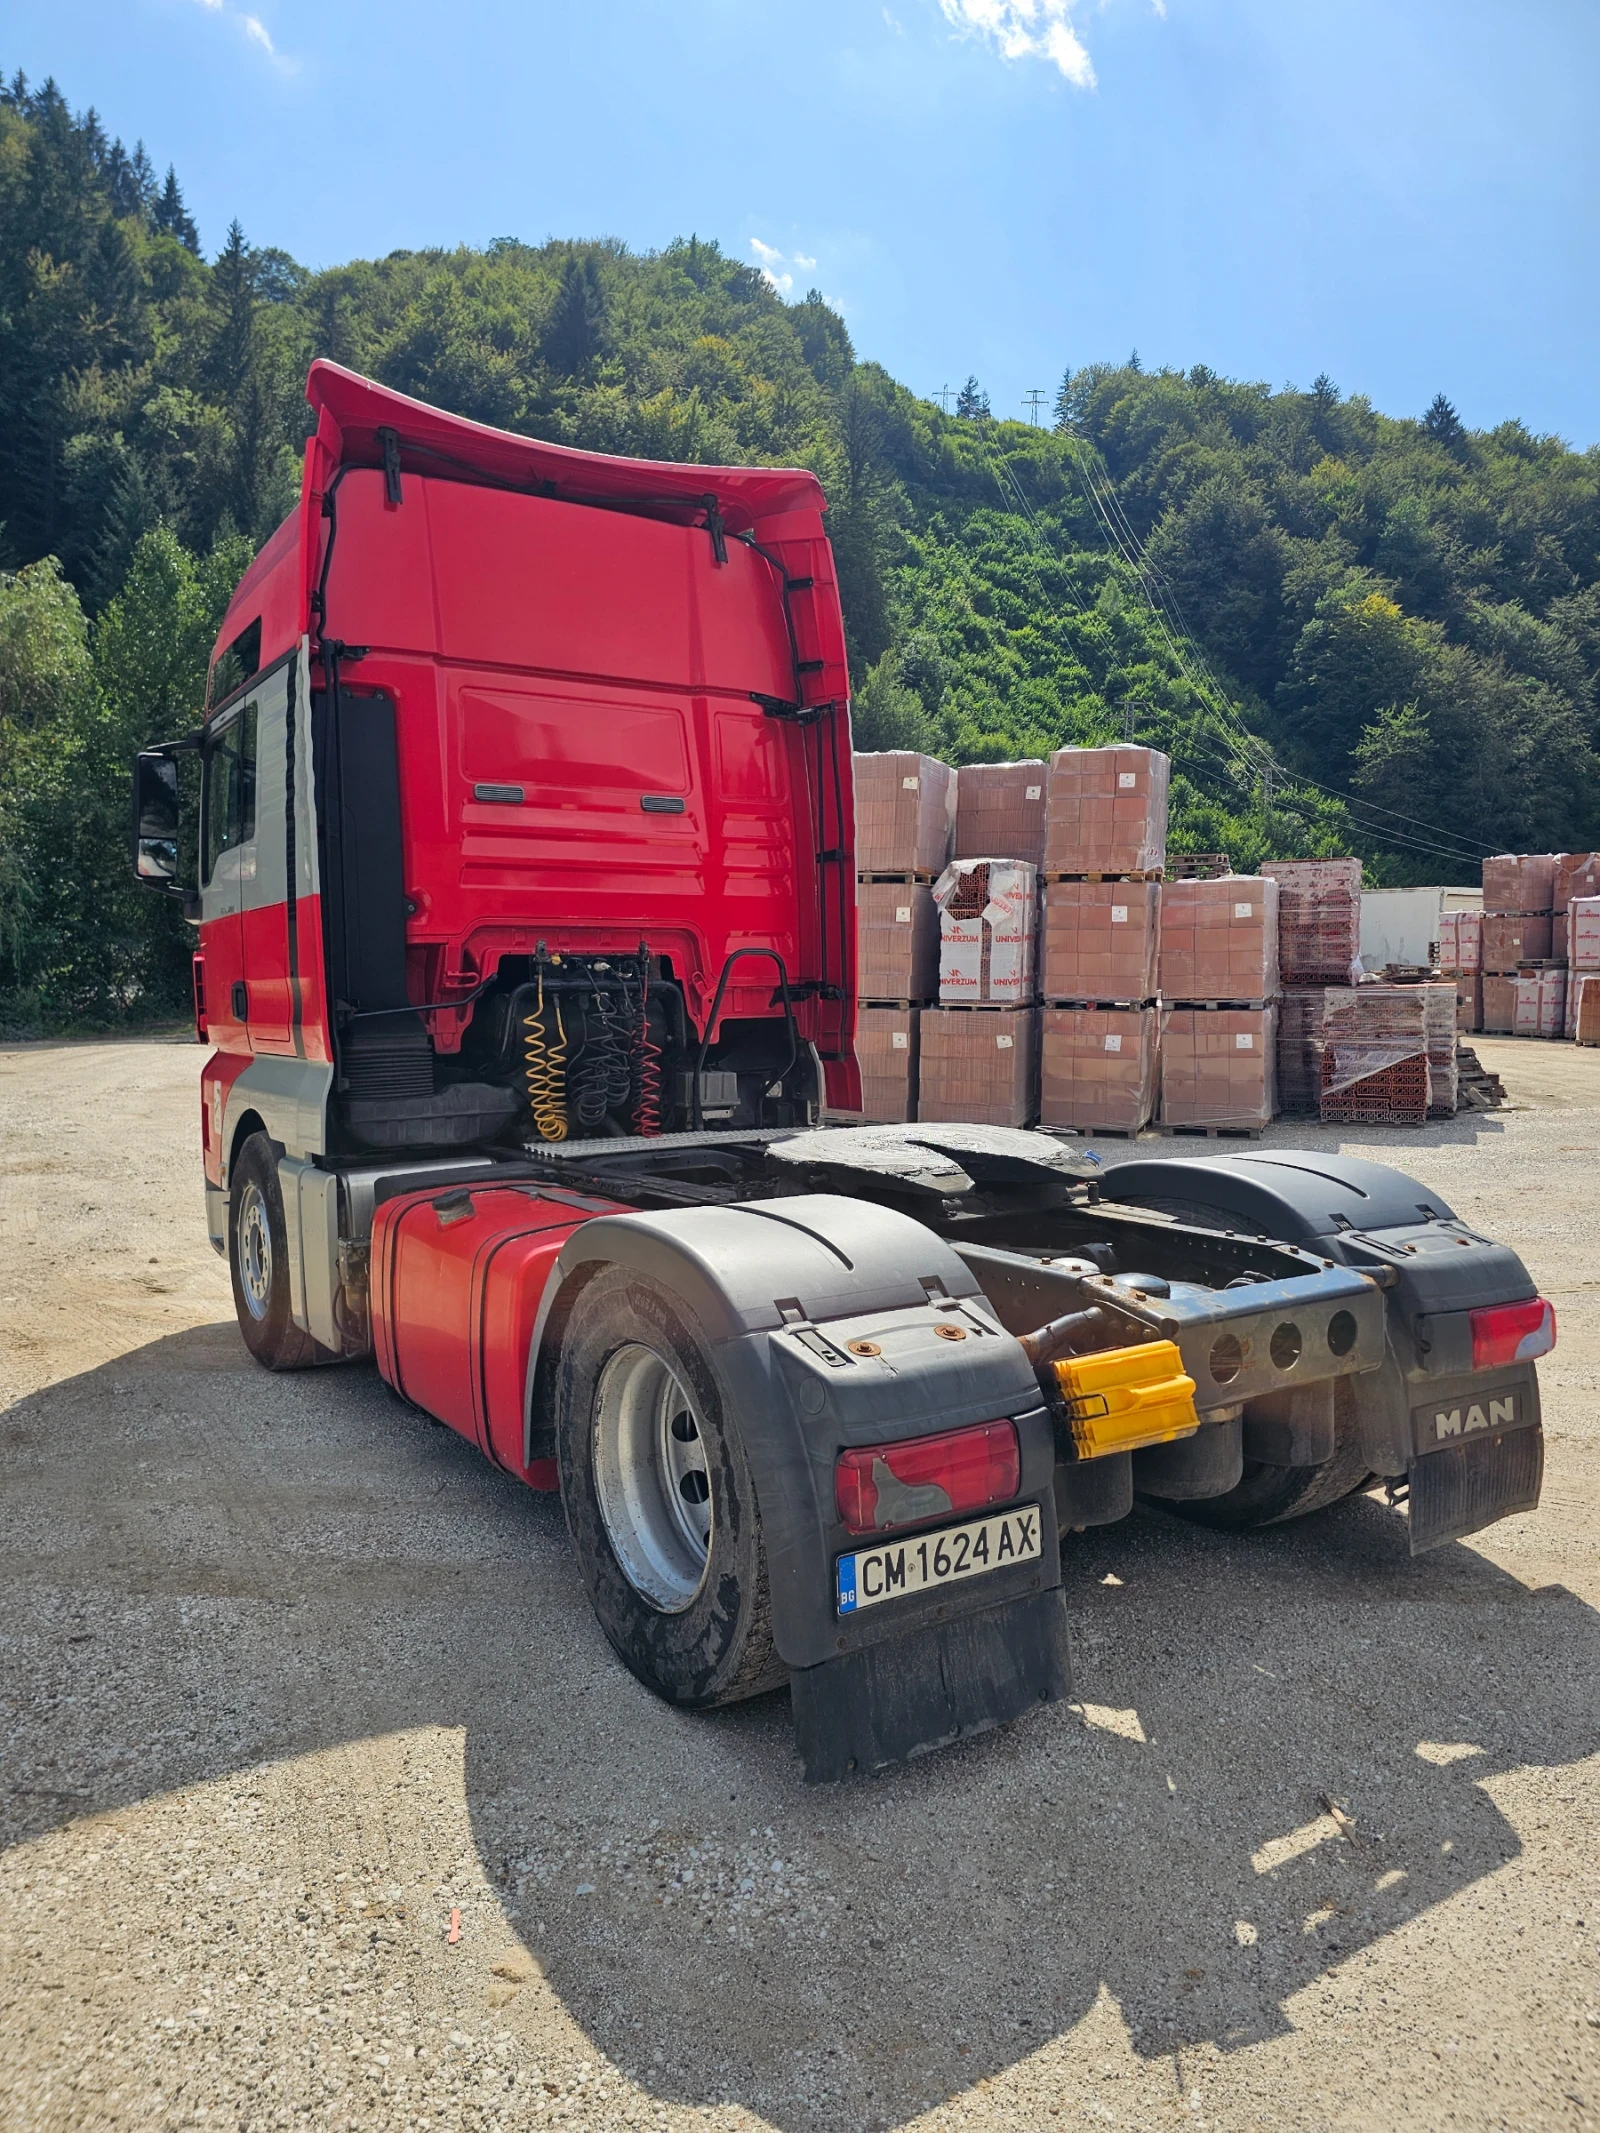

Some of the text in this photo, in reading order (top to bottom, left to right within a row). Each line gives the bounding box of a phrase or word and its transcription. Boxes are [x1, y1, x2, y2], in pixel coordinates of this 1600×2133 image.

[1435, 1396, 1514, 1440] MAN
[863, 1514, 1035, 1597] CM 1624 AX
[841, 1590, 855, 1604] BG
